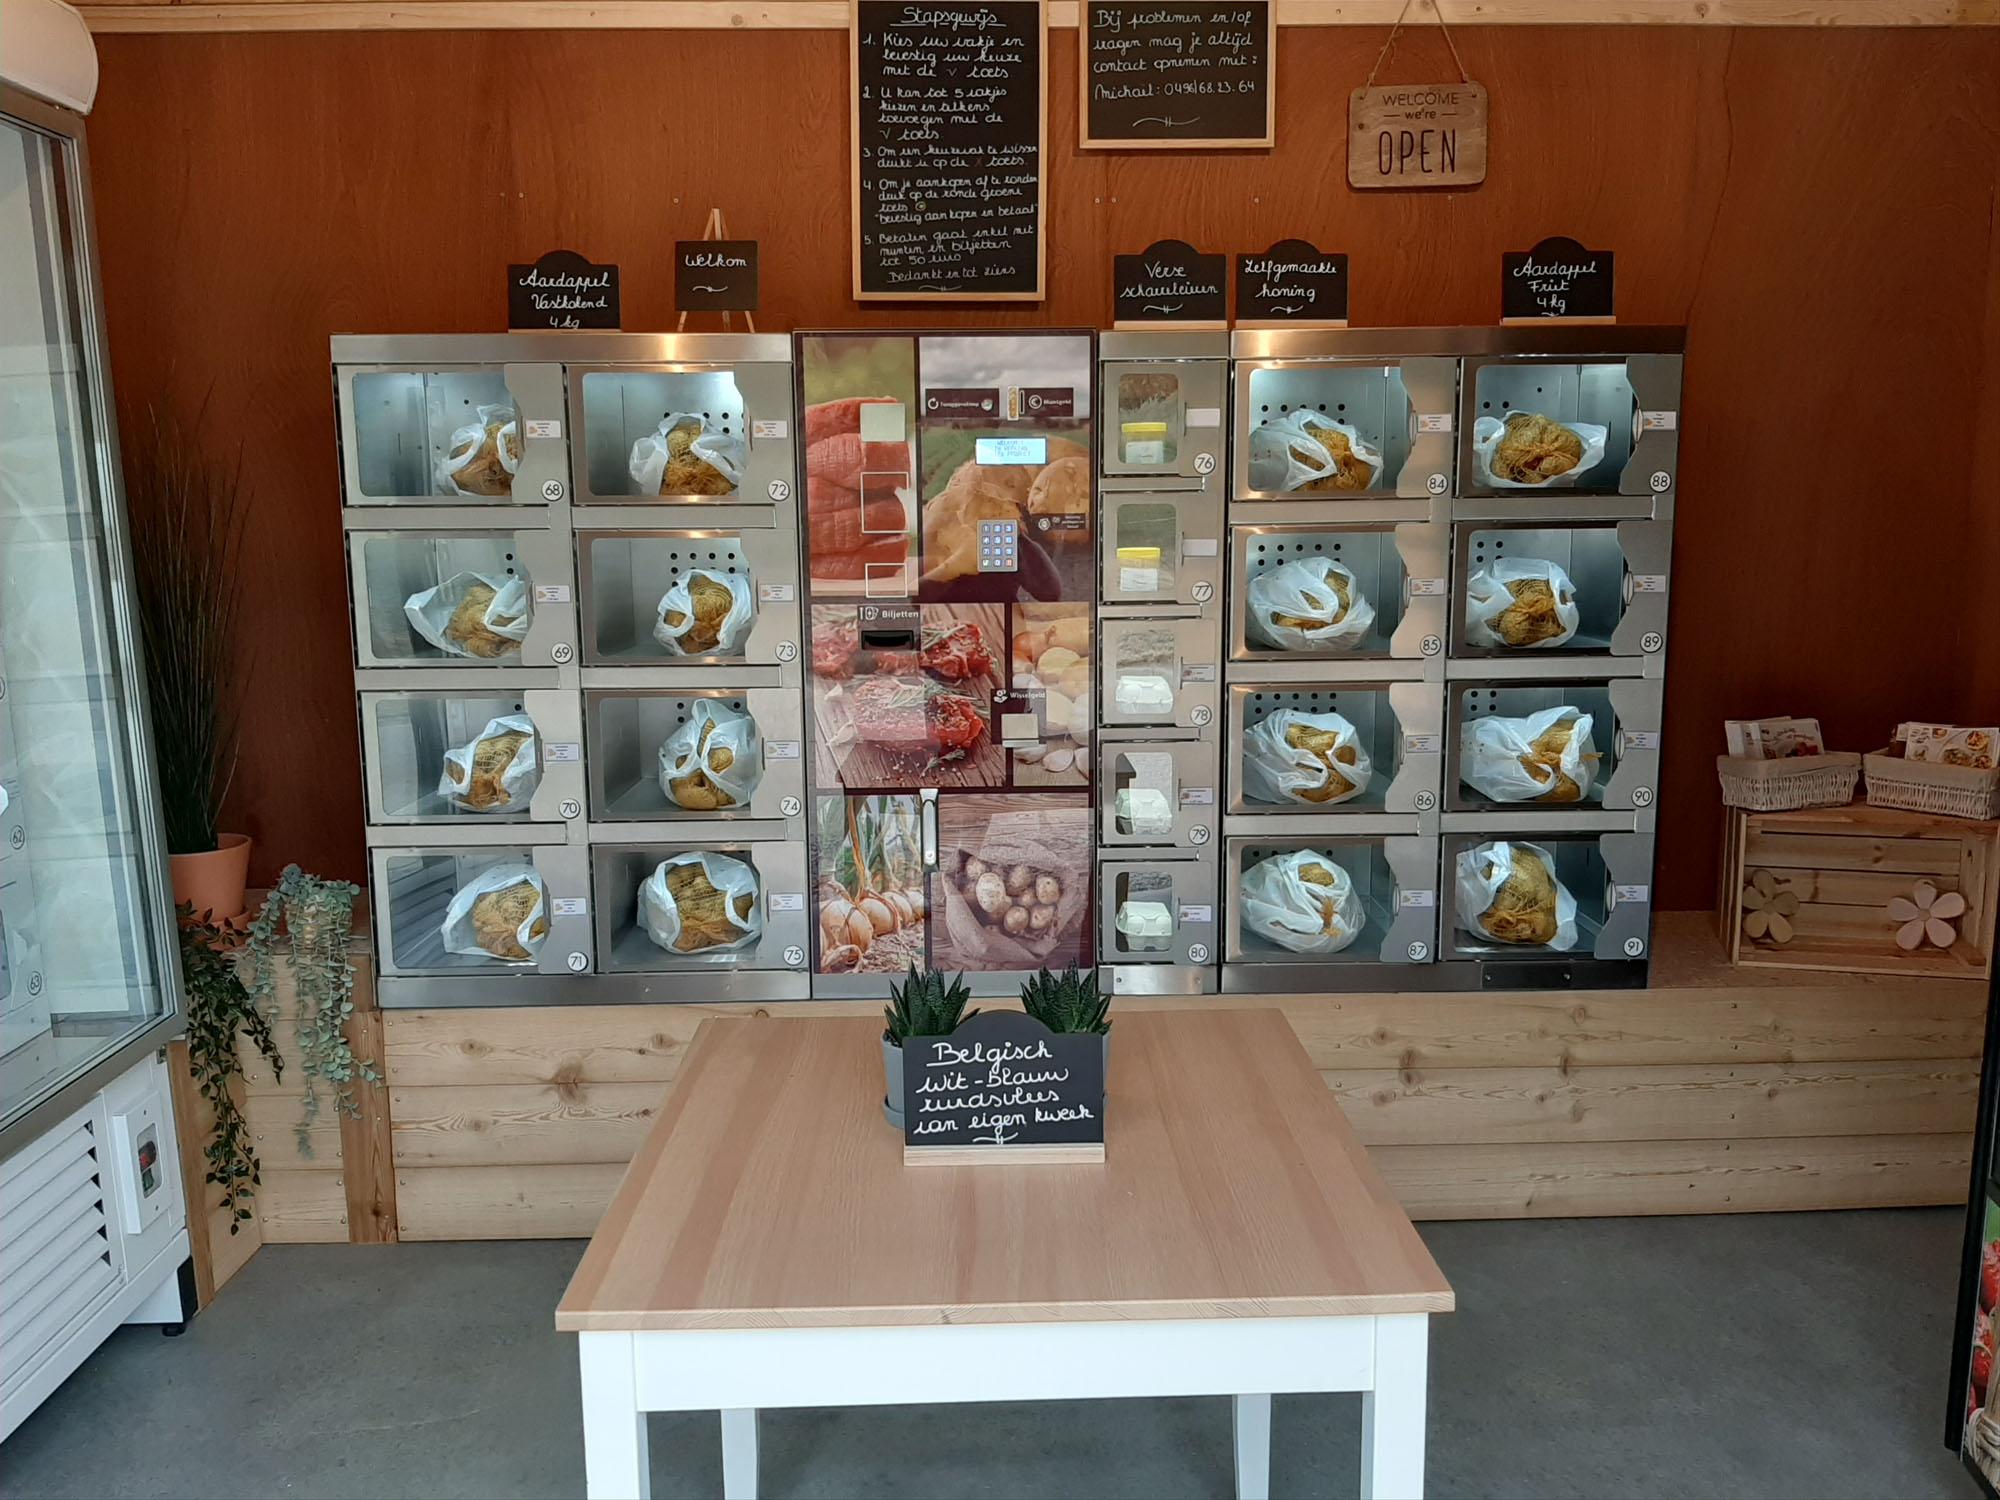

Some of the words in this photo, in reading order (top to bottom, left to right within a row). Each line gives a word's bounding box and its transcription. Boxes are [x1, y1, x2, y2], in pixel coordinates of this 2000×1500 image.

[901, 6, 998, 32] Stapsgewijs
[1094, 9, 1122, 33] Bij
[1127, 10, 1202, 30] problemen
[883, 31, 914, 48] Kies
[919, 36, 950, 48] uw
[951, 34, 995, 54] vakje
[1000, 37, 1025, 47] en
[1092, 38, 1142, 57] vragen
[1149, 36, 1183, 54] mag
[1188, 31, 1203, 54] je
[1207, 30, 1254, 55] altijd
[942, 53, 971, 62] uw
[973, 51, 1023, 63] keuze
[882, 64, 912, 76] met
[916, 63, 938, 78] de
[1093, 60, 1148, 74] contact
[1153, 57, 1211, 73] opnemen
[880, 86, 893, 99] U
[896, 86, 922, 98] kan
[923, 87, 949, 98] tot
[954, 87, 965, 99] 5
[1382, 92, 1460, 106] WELCOME
[920, 102, 937, 113] en
[1404, 107, 1437, 120] we're
[950, 113, 979, 125] met
[984, 112, 1004, 124] de
[896, 127, 940, 141] toets
[877, 144, 897, 157] Om
[899, 146, 922, 157] een
[986, 144, 999, 155] te
[1378, 128, 1456, 176] OPEN
[932, 158, 949, 171] op
[949, 157, 970, 168] de
[878, 178, 899, 191] Om
[975, 175, 989, 190] af
[991, 174, 1002, 185] te
[908, 190, 923, 202] op
[924, 189, 940, 199] de
[941, 188, 978, 199] ronde
[979, 187, 1024, 201] groene
[980, 209, 995, 218] en
[878, 232, 929, 245] Betalen
[932, 228, 969, 245] gaat
[1012, 223, 1035, 236] met
[879, 244, 925, 257] munten
[927, 243, 946, 254] en
[951, 239, 1013, 256] biljetten
[684, 252, 748, 267] Welkom
[879, 256, 903, 268] tot
[908, 254, 927, 266] 50
[886, 270, 944, 284] Bedankt
[944, 269, 961, 279] en
[962, 265, 979, 279] tot
[983, 263, 1017, 277] ziens
[1144, 260, 1187, 279] Verse
[1244, 259, 1337, 283] Zelfgemaakte
[1513, 256, 1597, 281] Aardappel
[519, 268, 611, 294] Aardappel
[1527, 279, 1570, 293] Friet
[1255, 284, 1316, 303] honing
[531, 293, 609, 310] Vastkokend
[1197, 457, 1213, 469] 76
[1429, 478, 1445, 489] 84
[1652, 476, 1668, 488] 88
[545, 484, 561, 496] 68
[771, 484, 787, 496] 72
[1195, 585, 1210, 596] 77
[882, 610, 919, 619] Biljetten
[1422, 639, 1438, 651] 85
[1643, 636, 1660, 648] 89
[554, 647, 570, 659] 69
[778, 645, 794, 657] 73
[1193, 709, 1209, 721] 78
[1416, 794, 1432, 806] 86
[1634, 790, 1651, 802] 90
[562, 803, 578, 814] 70
[782, 800, 798, 812] 74
[12, 829, 23, 845] 62
[1191, 829, 1207, 840] 79
[1409, 945, 1425, 956] 87
[1627, 940, 1641, 951] 91
[785, 950, 801, 961] 75
[1189, 947, 1206, 958] 80
[570, 956, 585, 967] 71
[29, 975, 41, 991] 63
[926, 1040, 1053, 1074] Belgisch
[919, 1087, 1060, 1113] rundsvlees
[913, 1117, 959, 1135] van
[968, 1111, 1027, 1135] eigen
[1034, 1103, 1095, 1123] kweek
